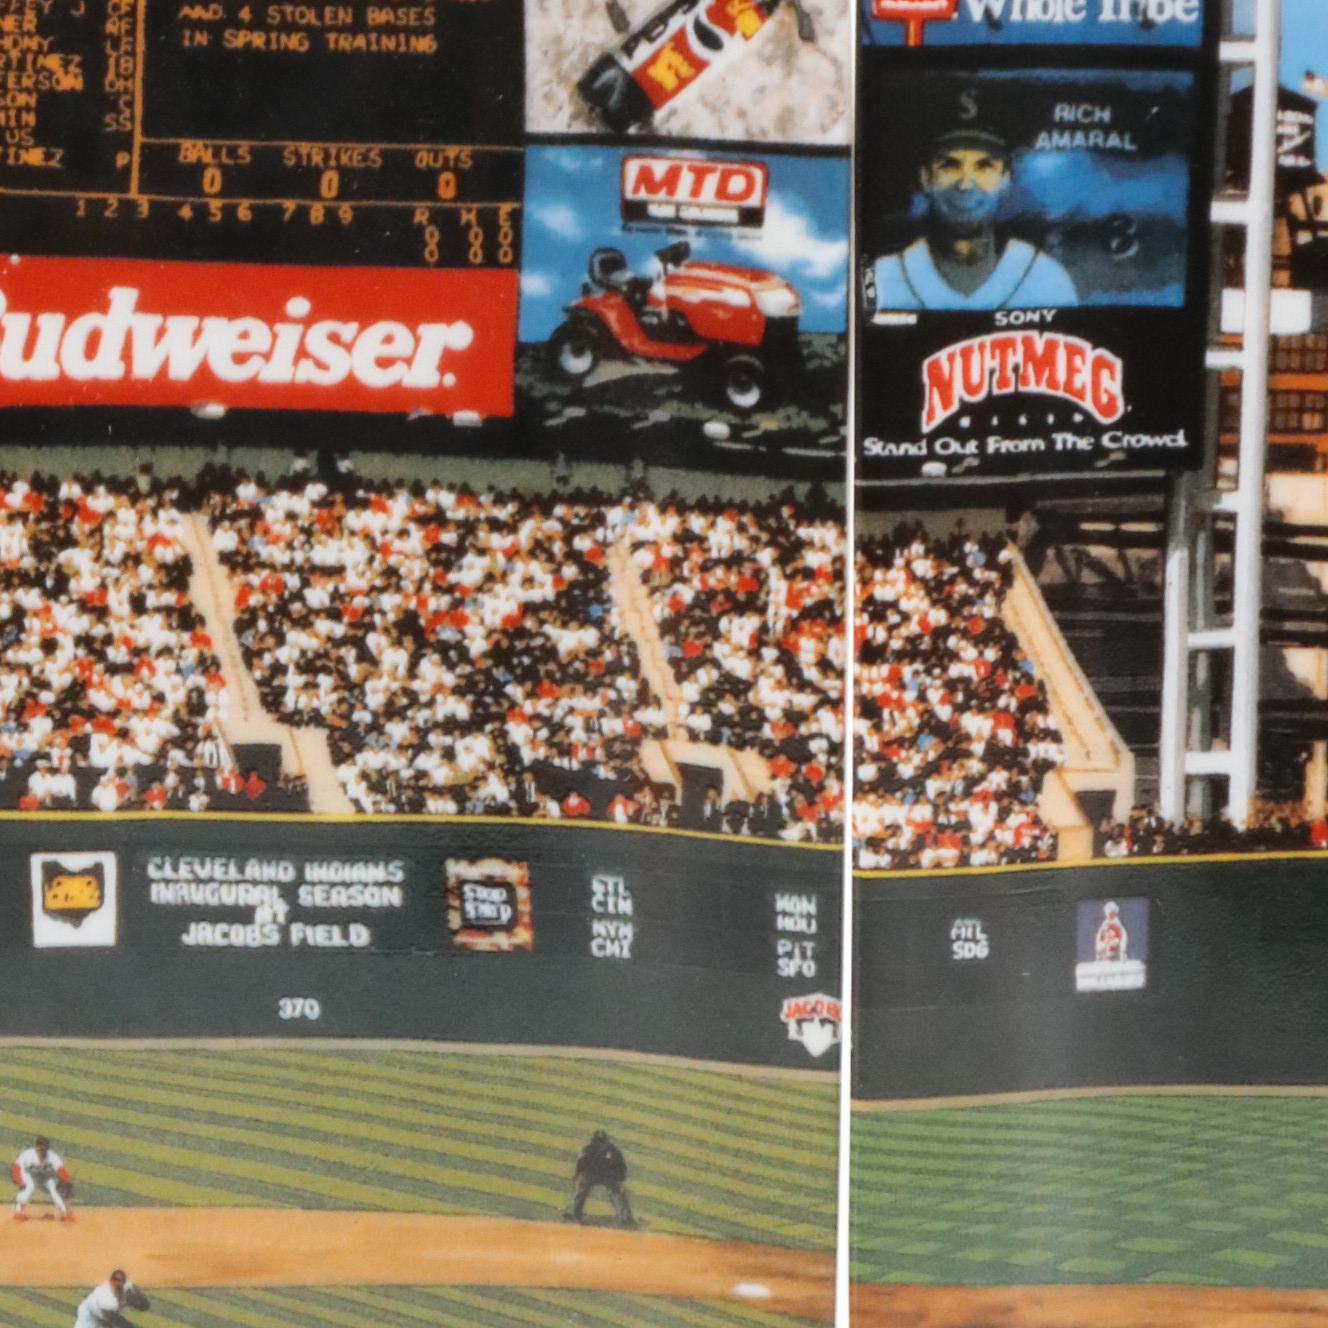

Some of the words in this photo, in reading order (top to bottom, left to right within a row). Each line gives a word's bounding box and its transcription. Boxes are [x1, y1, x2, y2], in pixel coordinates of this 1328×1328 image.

[238, 5, 252, 23] 4
[267, 5, 353, 26] STOLEN
[366, 7, 437, 26] BASES
[182, 29, 209, 47] IN
[223, 29, 311, 52] SPRING
[324, 32, 440, 54] TRAINING
[1054, 102, 1113, 125] RICH
[1033, 130, 1139, 152] AMARAL
[177, 142, 252, 164] BALLS
[282, 147, 382, 168] STRIKES
[414, 149, 473, 170] OUTS
[202, 167, 222, 195] 0
[320, 170, 340, 200] 0
[437, 171, 457, 200] 0
[631, 164, 757, 202] MTD
[76, 199, 87, 217] 1
[104, 200, 120, 218] 2
[136, 200, 150, 219] 3
[177, 203, 194, 222] 4
[208, 203, 223, 223] 5
[236, 203, 253, 222] 6
[282, 202, 297, 222] 7
[309, 205, 325, 226] 8
[338, 205, 353, 226] 9
[412, 207, 430, 226] R
[993, 308, 1058, 328] SONY
[921, 329, 1125, 435] NUTMEG
[863, 436, 928, 457] Stand
[933, 436, 980, 457] Out
[986, 436, 1046, 455] From
[1051, 431, 1095, 451] The
[1100, 428, 1190, 449] Crowd
[147, 855, 297, 883] CLEVELAND
[304, 860, 405, 883] INDIANS
[150, 882, 285, 906] INAUGURAL
[297, 885, 404, 908] SEASON
[181, 922, 281, 948] JACOBS
[289, 923, 371, 947] FIELD
[951, 939, 991, 961] SDG
[278, 998, 322, 1021] 370
